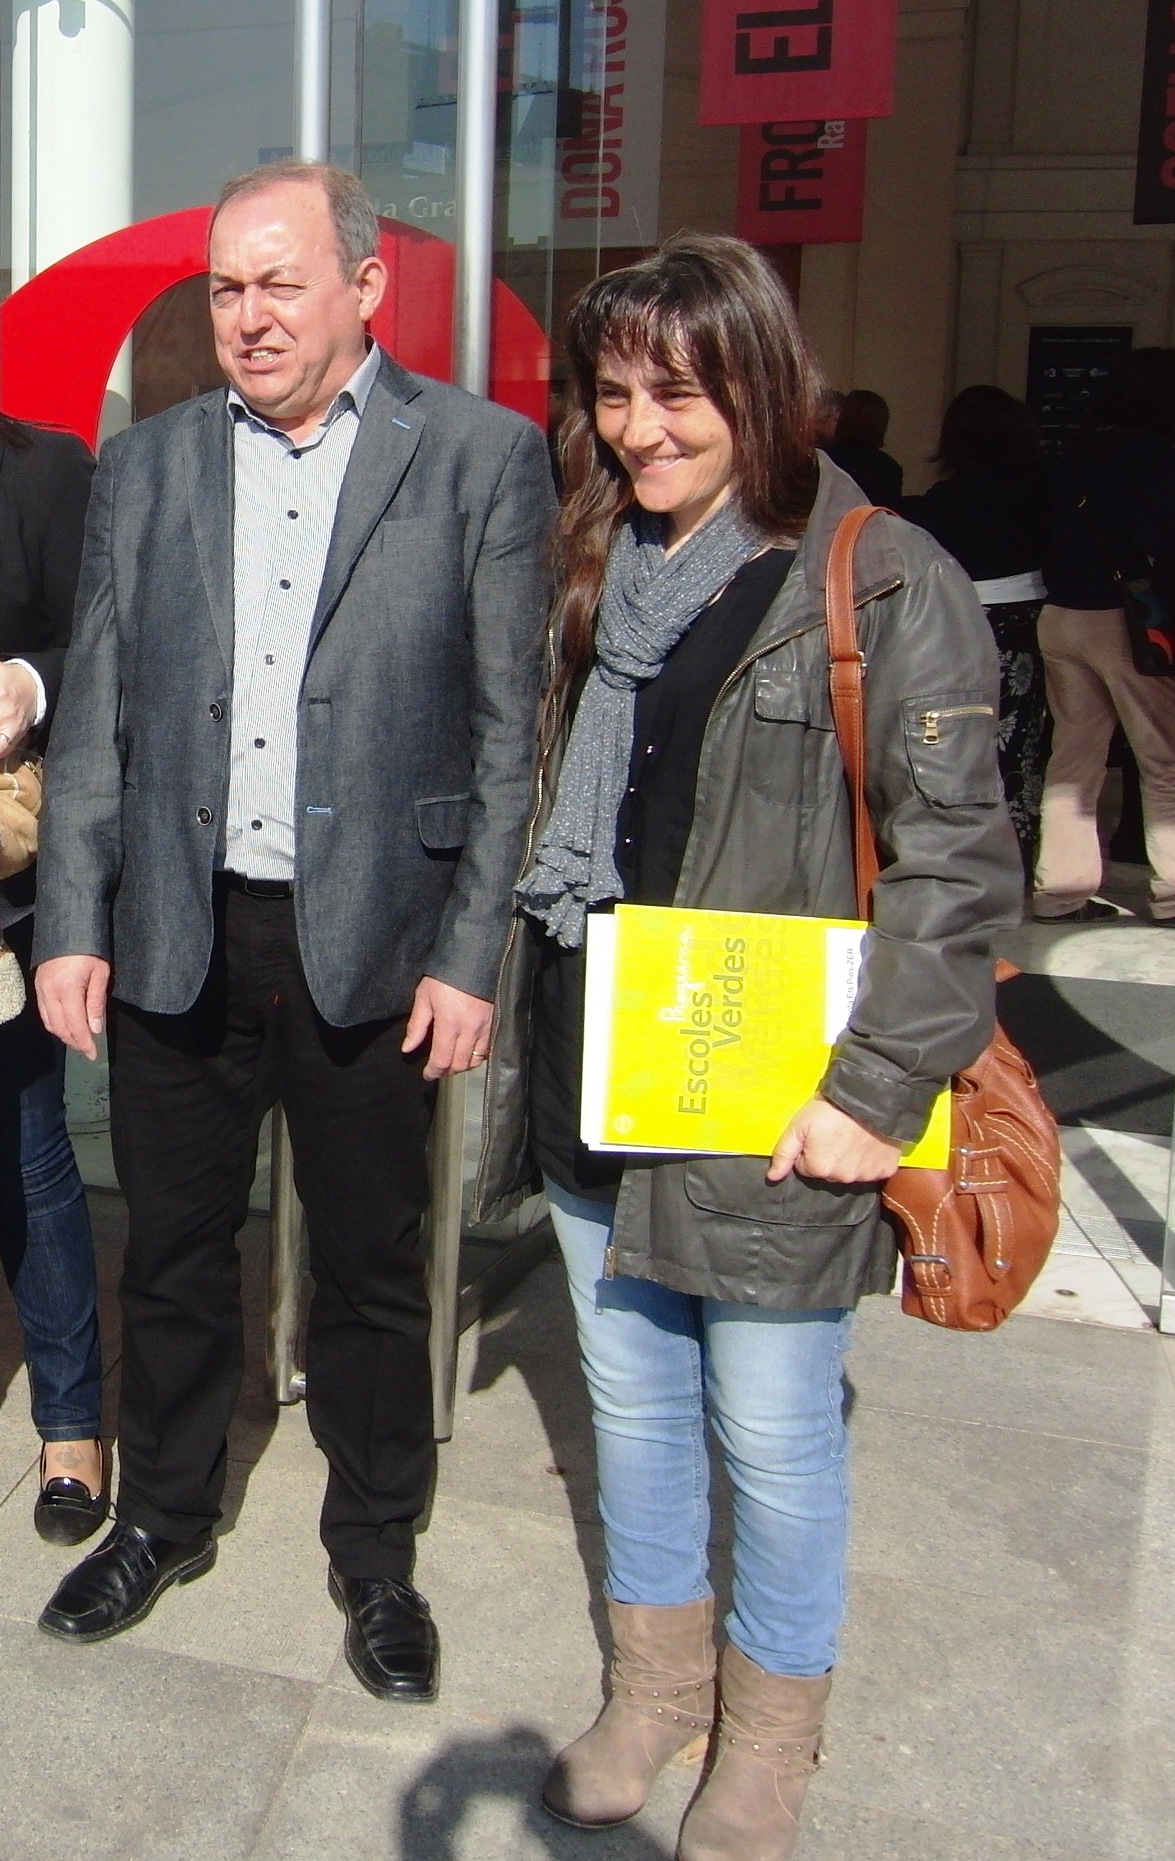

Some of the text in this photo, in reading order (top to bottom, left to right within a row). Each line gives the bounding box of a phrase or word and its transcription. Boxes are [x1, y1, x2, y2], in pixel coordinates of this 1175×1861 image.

[735, 0, 834, 75] EL
[712, 937, 745, 1048] Verdes
[678, 992, 713, 1114] Escoles
